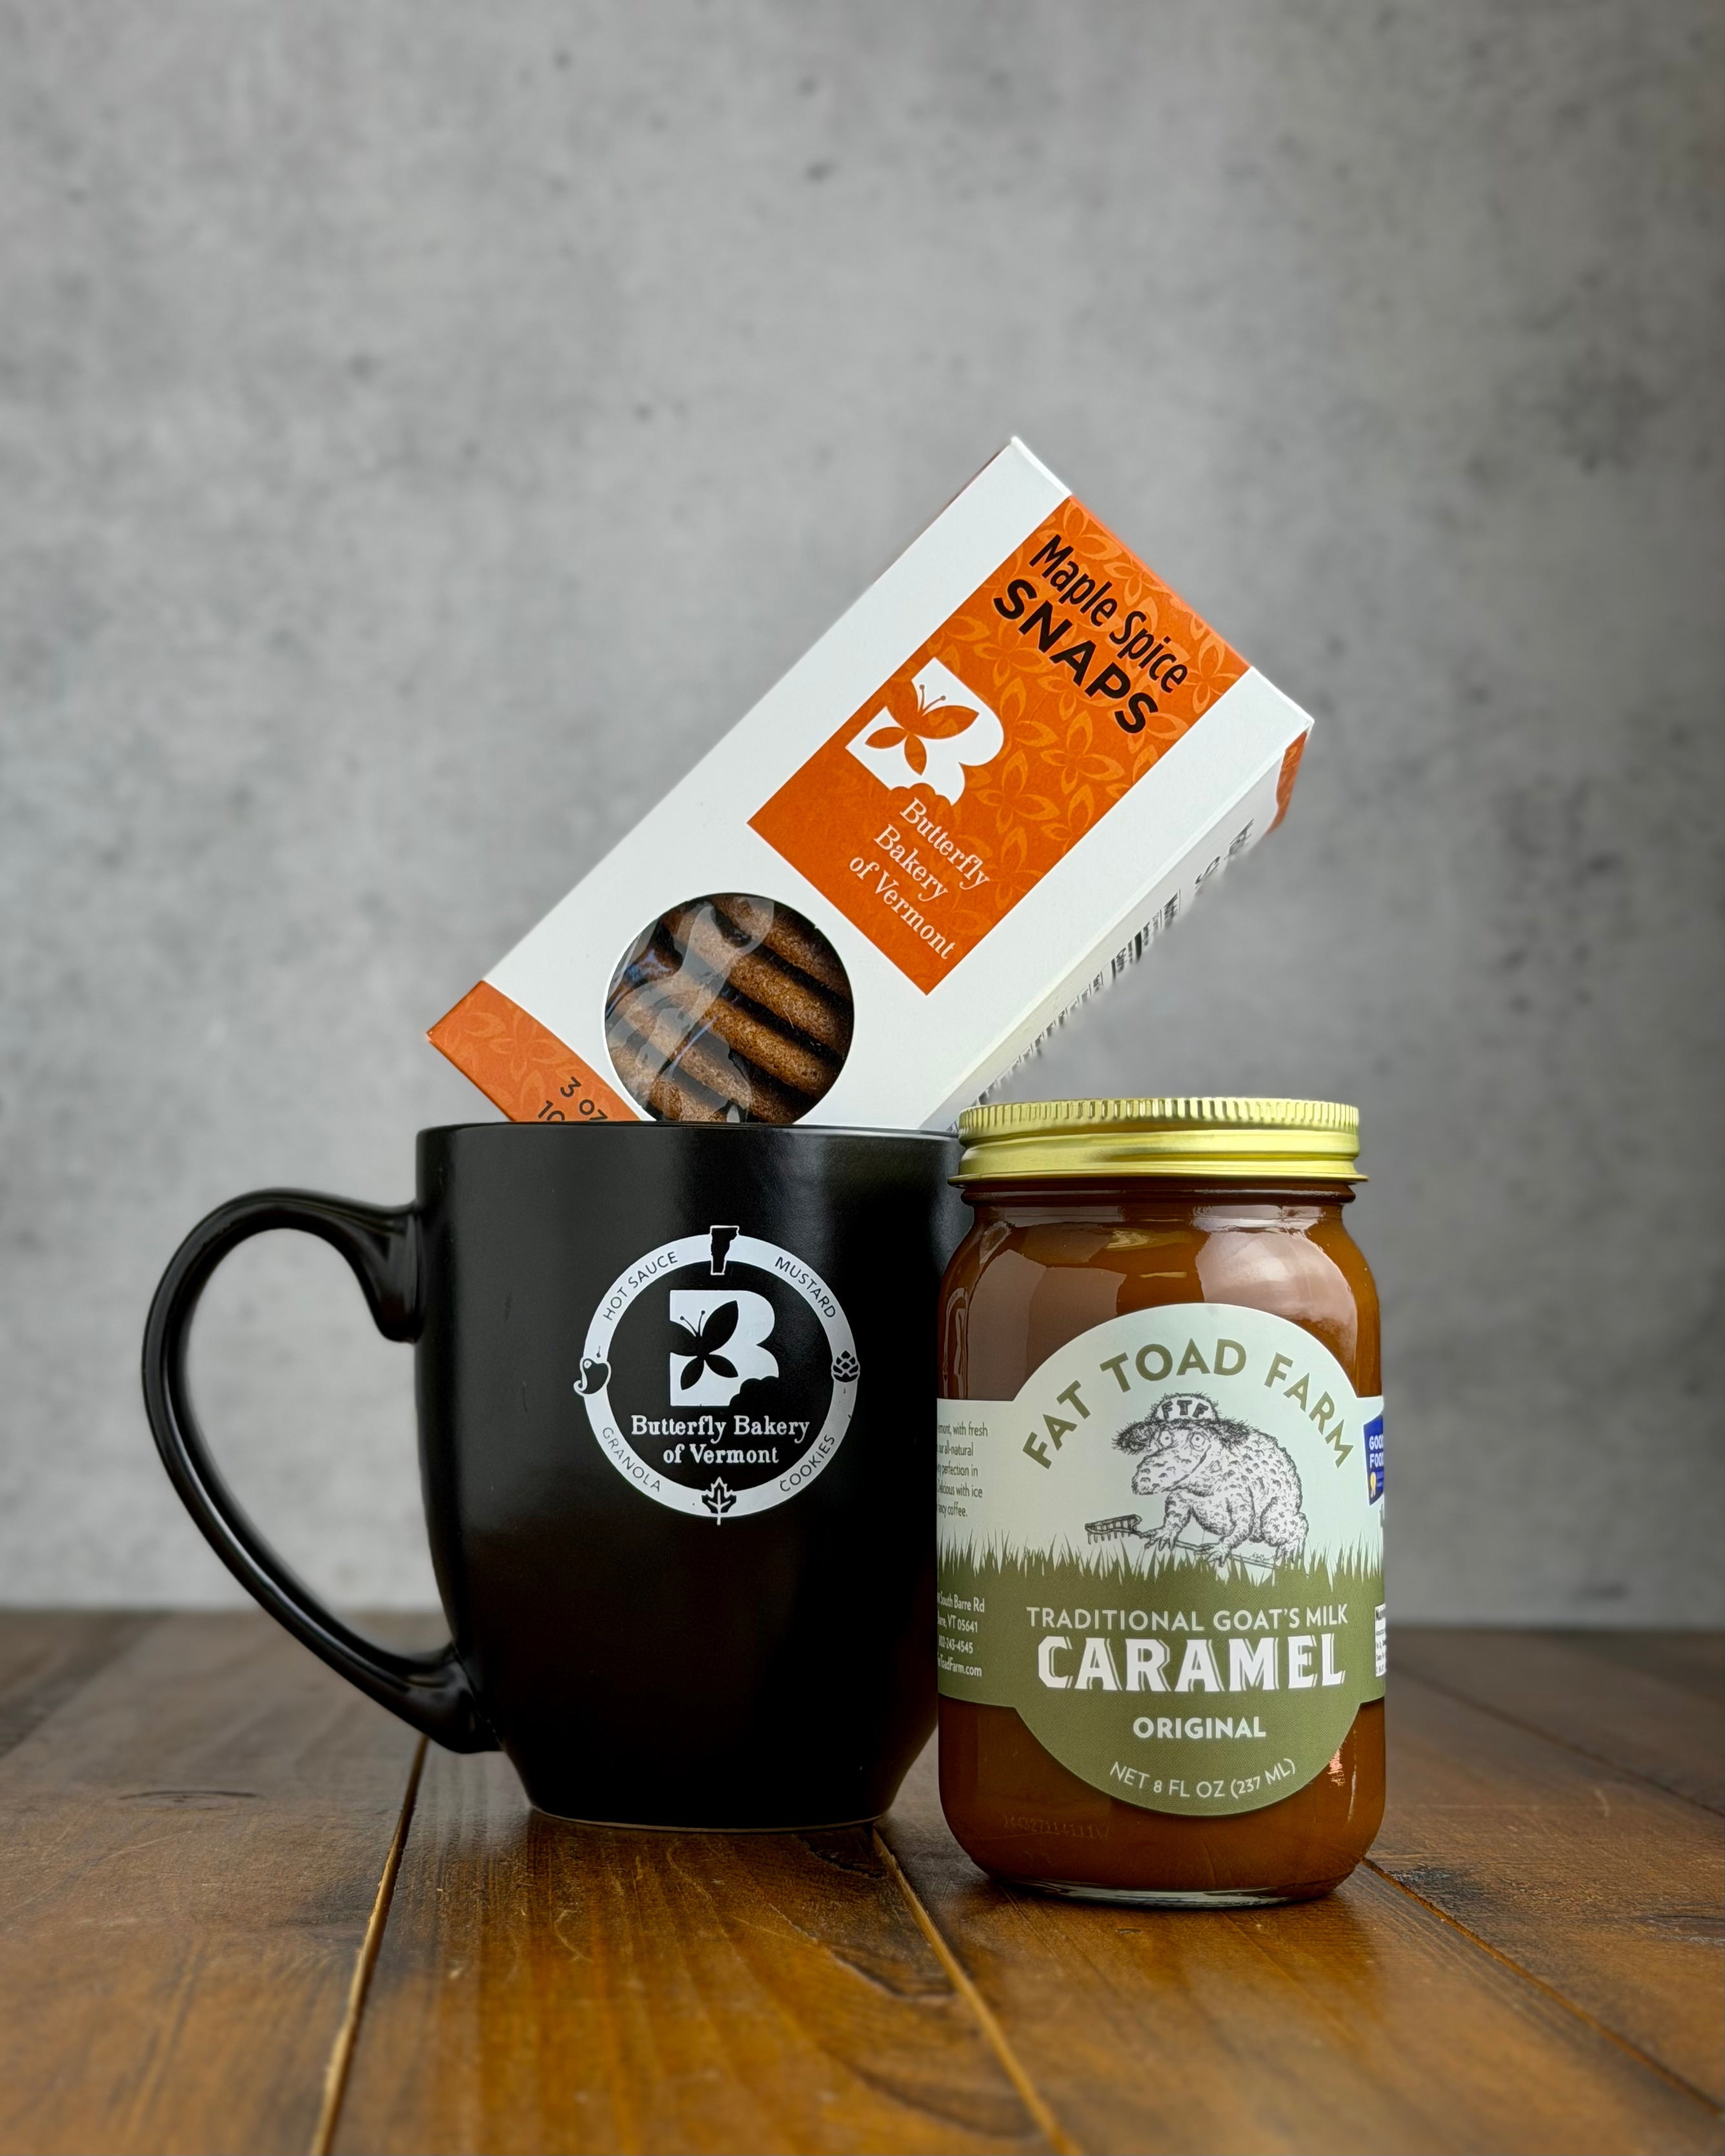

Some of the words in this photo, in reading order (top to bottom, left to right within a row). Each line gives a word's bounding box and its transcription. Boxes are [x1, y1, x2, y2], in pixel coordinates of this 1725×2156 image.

[1029, 534, 1118, 626] Maple
[1109, 611, 1187, 693] Spice
[993, 579, 1159, 734] SNAPS
[900, 797, 991, 891] Butterfly
[874, 824, 949, 902] Bakery
[849, 856, 880, 880] of
[874, 873, 956, 960] Vermont
[560, 1076, 581, 1098] 3
[603, 1289, 629, 1320] HOT
[628, 1251, 678, 1289] SAUCE
[775, 1256, 836, 1318] MUSTARD
[1023, 1380, 1091, 1469] FAT
[1100, 1338, 1246, 1393] TOAD
[1264, 1353, 1354, 1468] FARM
[1162, 1400, 1209, 1419] FTF
[631, 1415, 727, 1444] Butterfly
[734, 1415, 811, 1444] Bakery
[953, 1422, 967, 1436] with
[968, 1421, 989, 1436] fresh
[602, 1427, 662, 1493] GRANOLA
[663, 1444, 686, 1464] of
[690, 1444, 780, 1464] Vermont
[780, 1434, 836, 1492] COOKIES
[942, 1460, 969, 1477] perfection
[971, 1464, 978, 1477] in
[956, 1482, 969, 1497] with
[971, 1485, 983, 1498] ice
[947, 1501, 968, 1517] coffee.
[954, 1594, 971, 1611] Barre
[973, 1597, 985, 1613] Rd
[1026, 1607, 1204, 1631] TRADITIONAL
[1306, 1604, 1349, 1627] MILK
[947, 1614, 956, 1629] VT
[958, 1618, 978, 1633] 05641
[1038, 1633, 1346, 1692] CARAMEL
[1133, 1717, 1266, 1738] ORIGINAL
[1110, 1761, 1150, 1789] NET
[1154, 1780, 1162, 1793] 8
[1169, 1780, 1190, 1797] FL
[1196, 1780, 1226, 1798] OZ
[1231, 1776, 1261, 1799] (237
[1265, 1757, 1295, 1784] ML)
